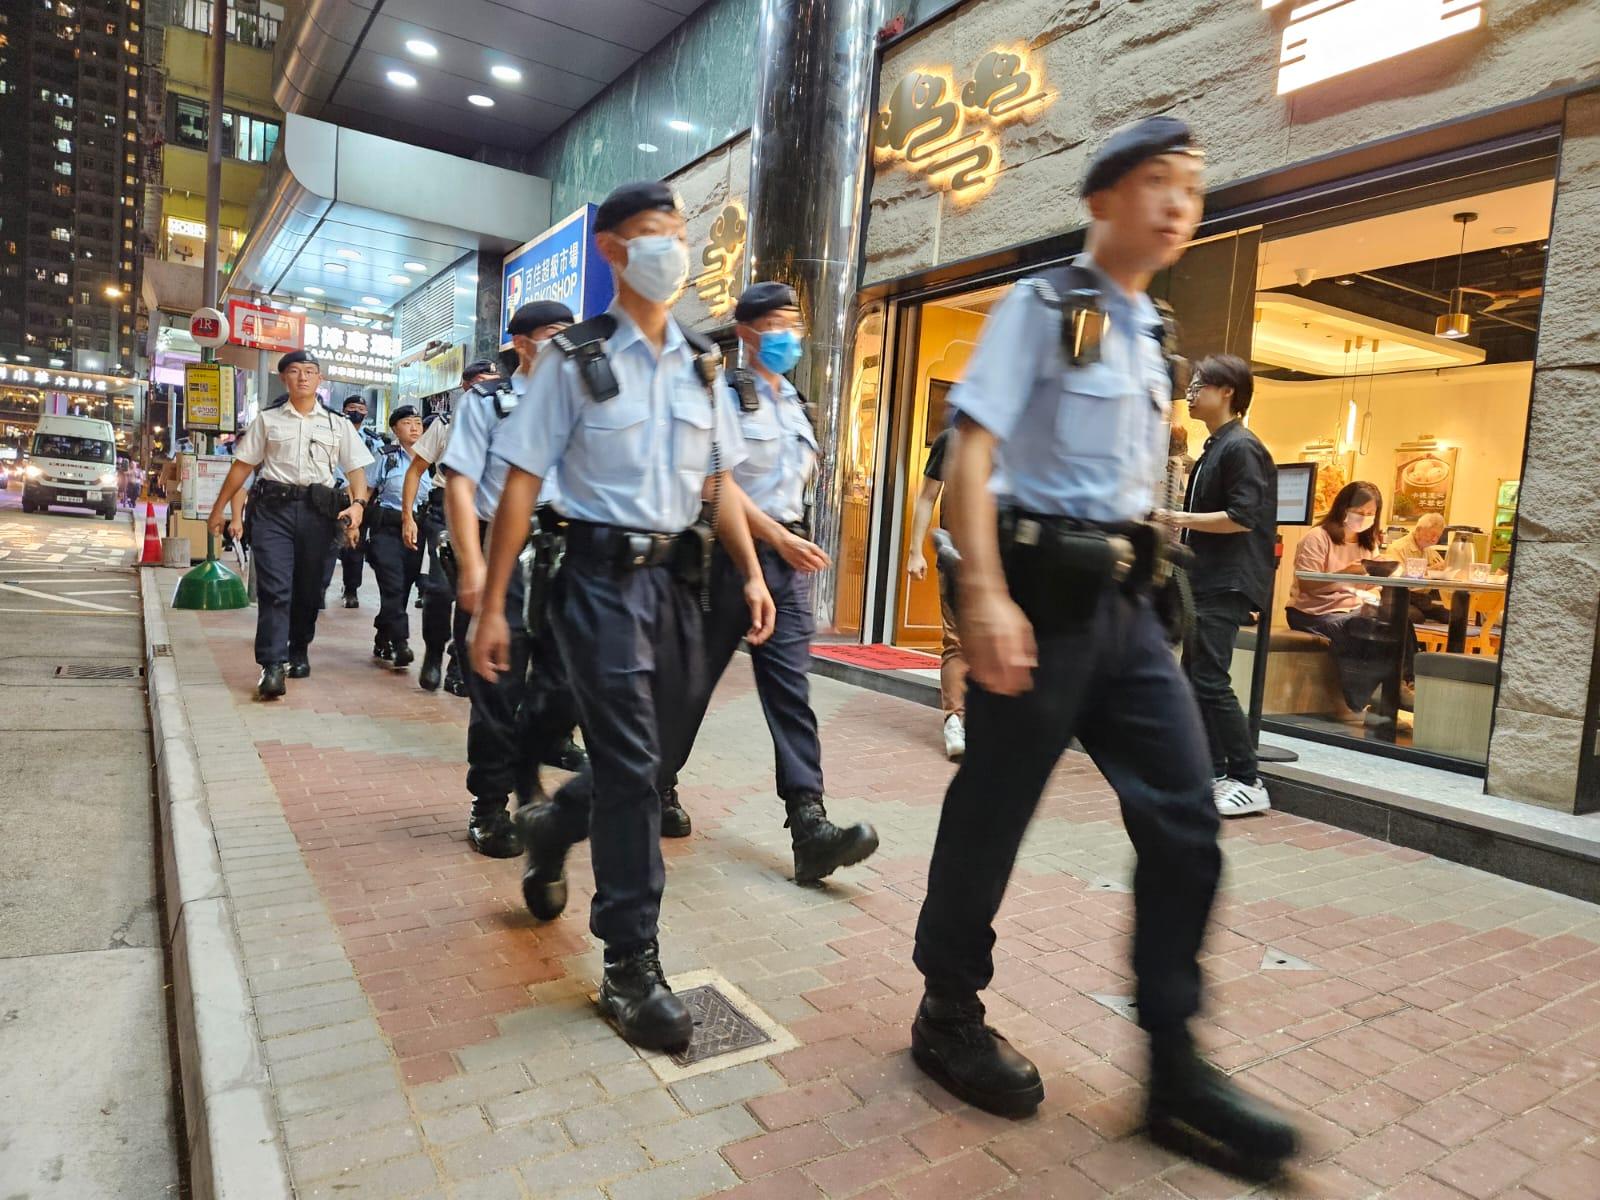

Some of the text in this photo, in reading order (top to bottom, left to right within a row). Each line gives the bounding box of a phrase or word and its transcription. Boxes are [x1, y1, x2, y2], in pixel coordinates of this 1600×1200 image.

[525, 241, 579, 290] 百佳超級市場
[335, 352, 394, 368] CARPARK
